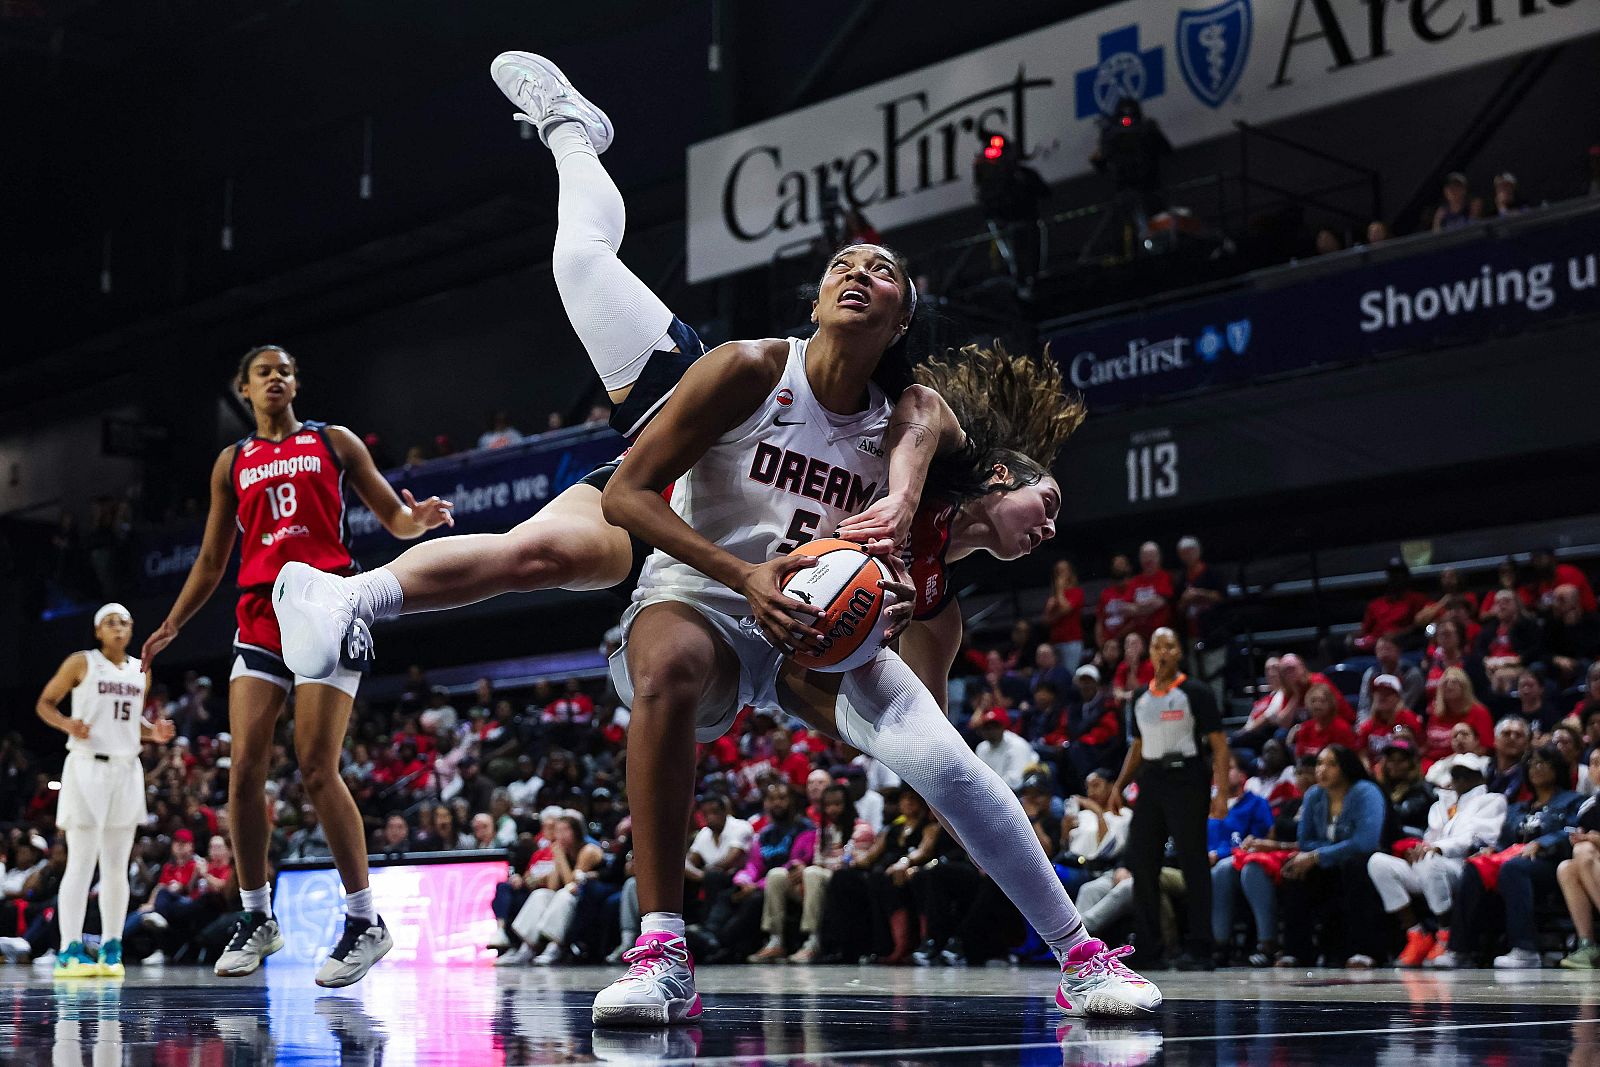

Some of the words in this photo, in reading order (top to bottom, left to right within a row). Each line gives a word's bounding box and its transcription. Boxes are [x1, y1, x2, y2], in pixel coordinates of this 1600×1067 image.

[722, 62, 1053, 242] CareFirst
[1360, 263, 1555, 332] Showing
[1070, 335, 1191, 389] CareFirst
[239, 455, 322, 491] Washington
[513, 474, 549, 501] we
[748, 440, 878, 514] DREAM
[1126, 441, 1179, 503] 113
[265, 482, 298, 521] 18
[775, 508, 821, 554] 5
[114, 700, 132, 721] 15
